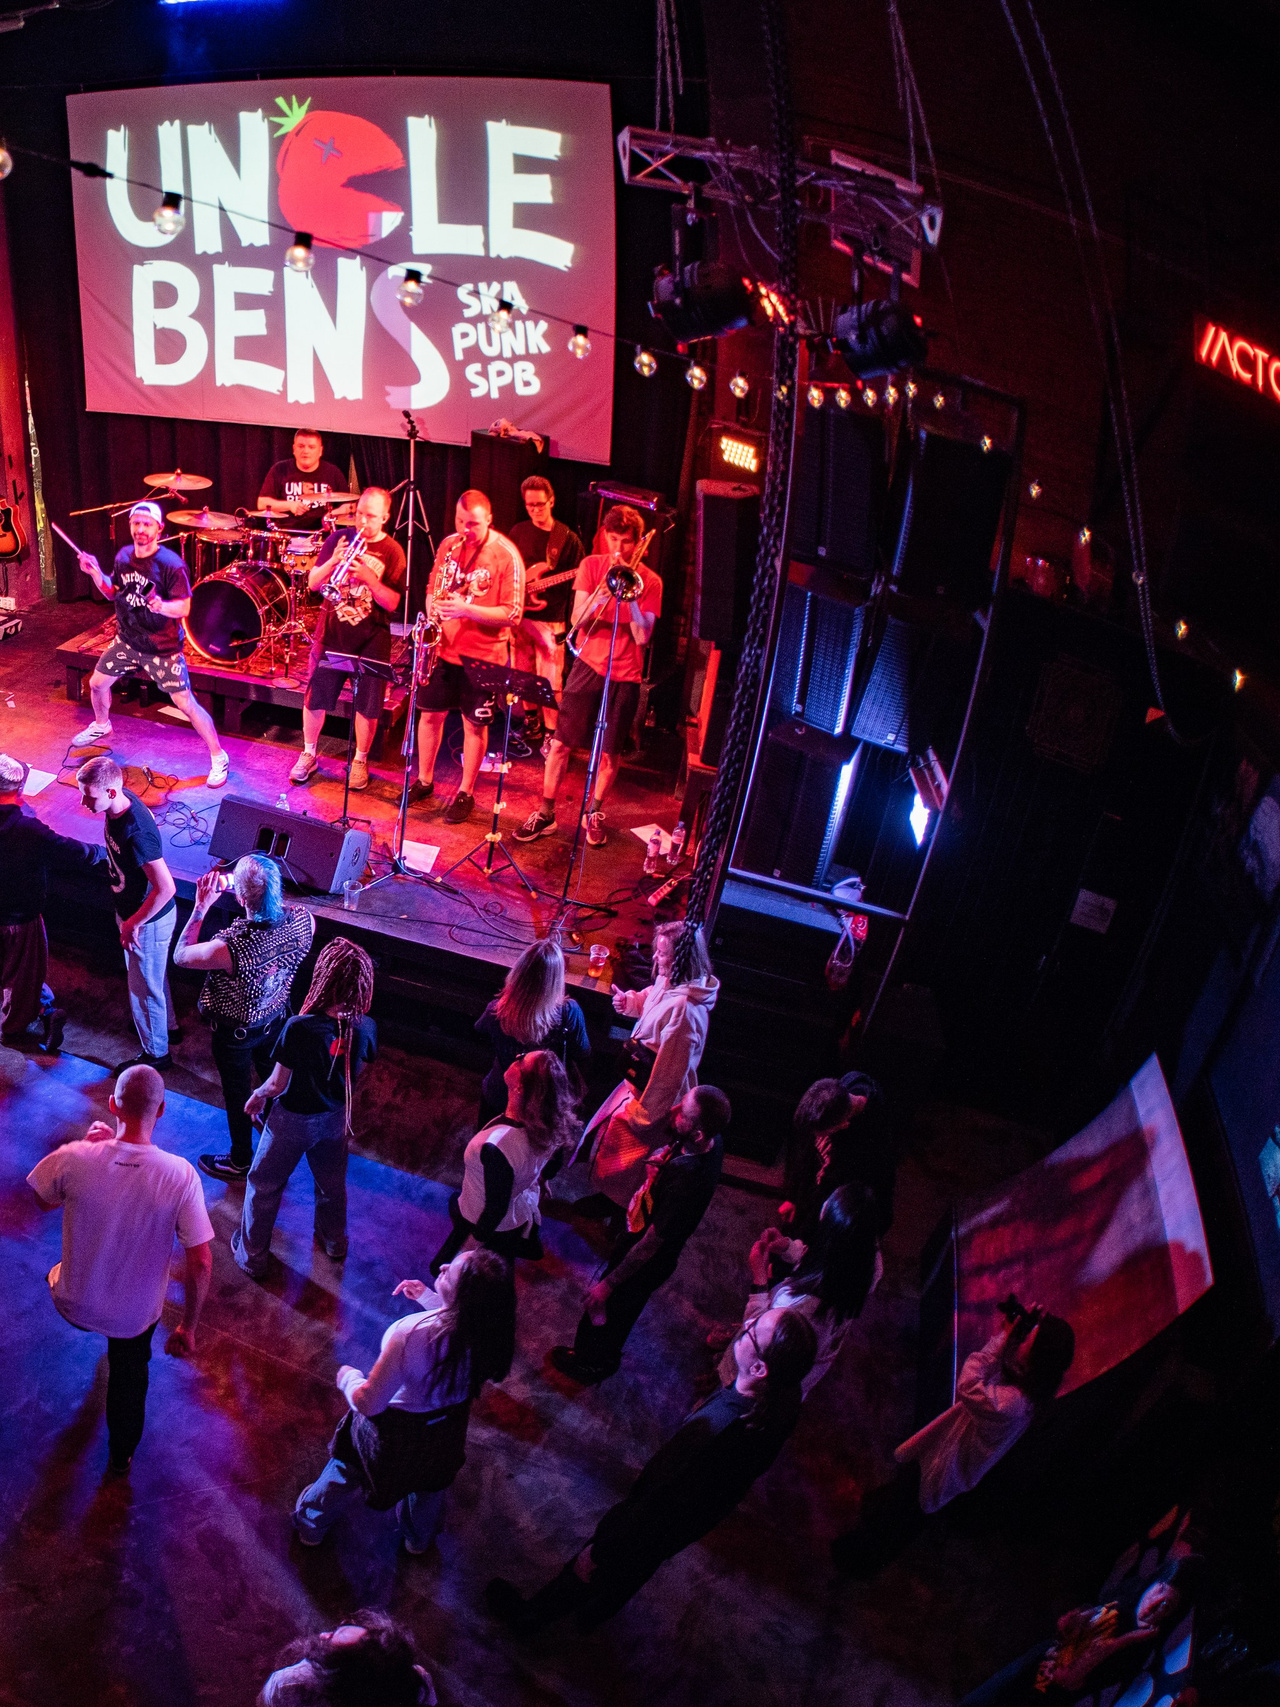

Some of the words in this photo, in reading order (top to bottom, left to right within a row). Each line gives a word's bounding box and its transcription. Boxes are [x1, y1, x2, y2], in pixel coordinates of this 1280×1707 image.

[106, 106, 575, 271] UNCLE
[457, 281, 529, 319] SKA
[132, 255, 450, 410] BENS
[451, 319, 551, 361] PUNK
[465, 360, 542, 399] SPB
